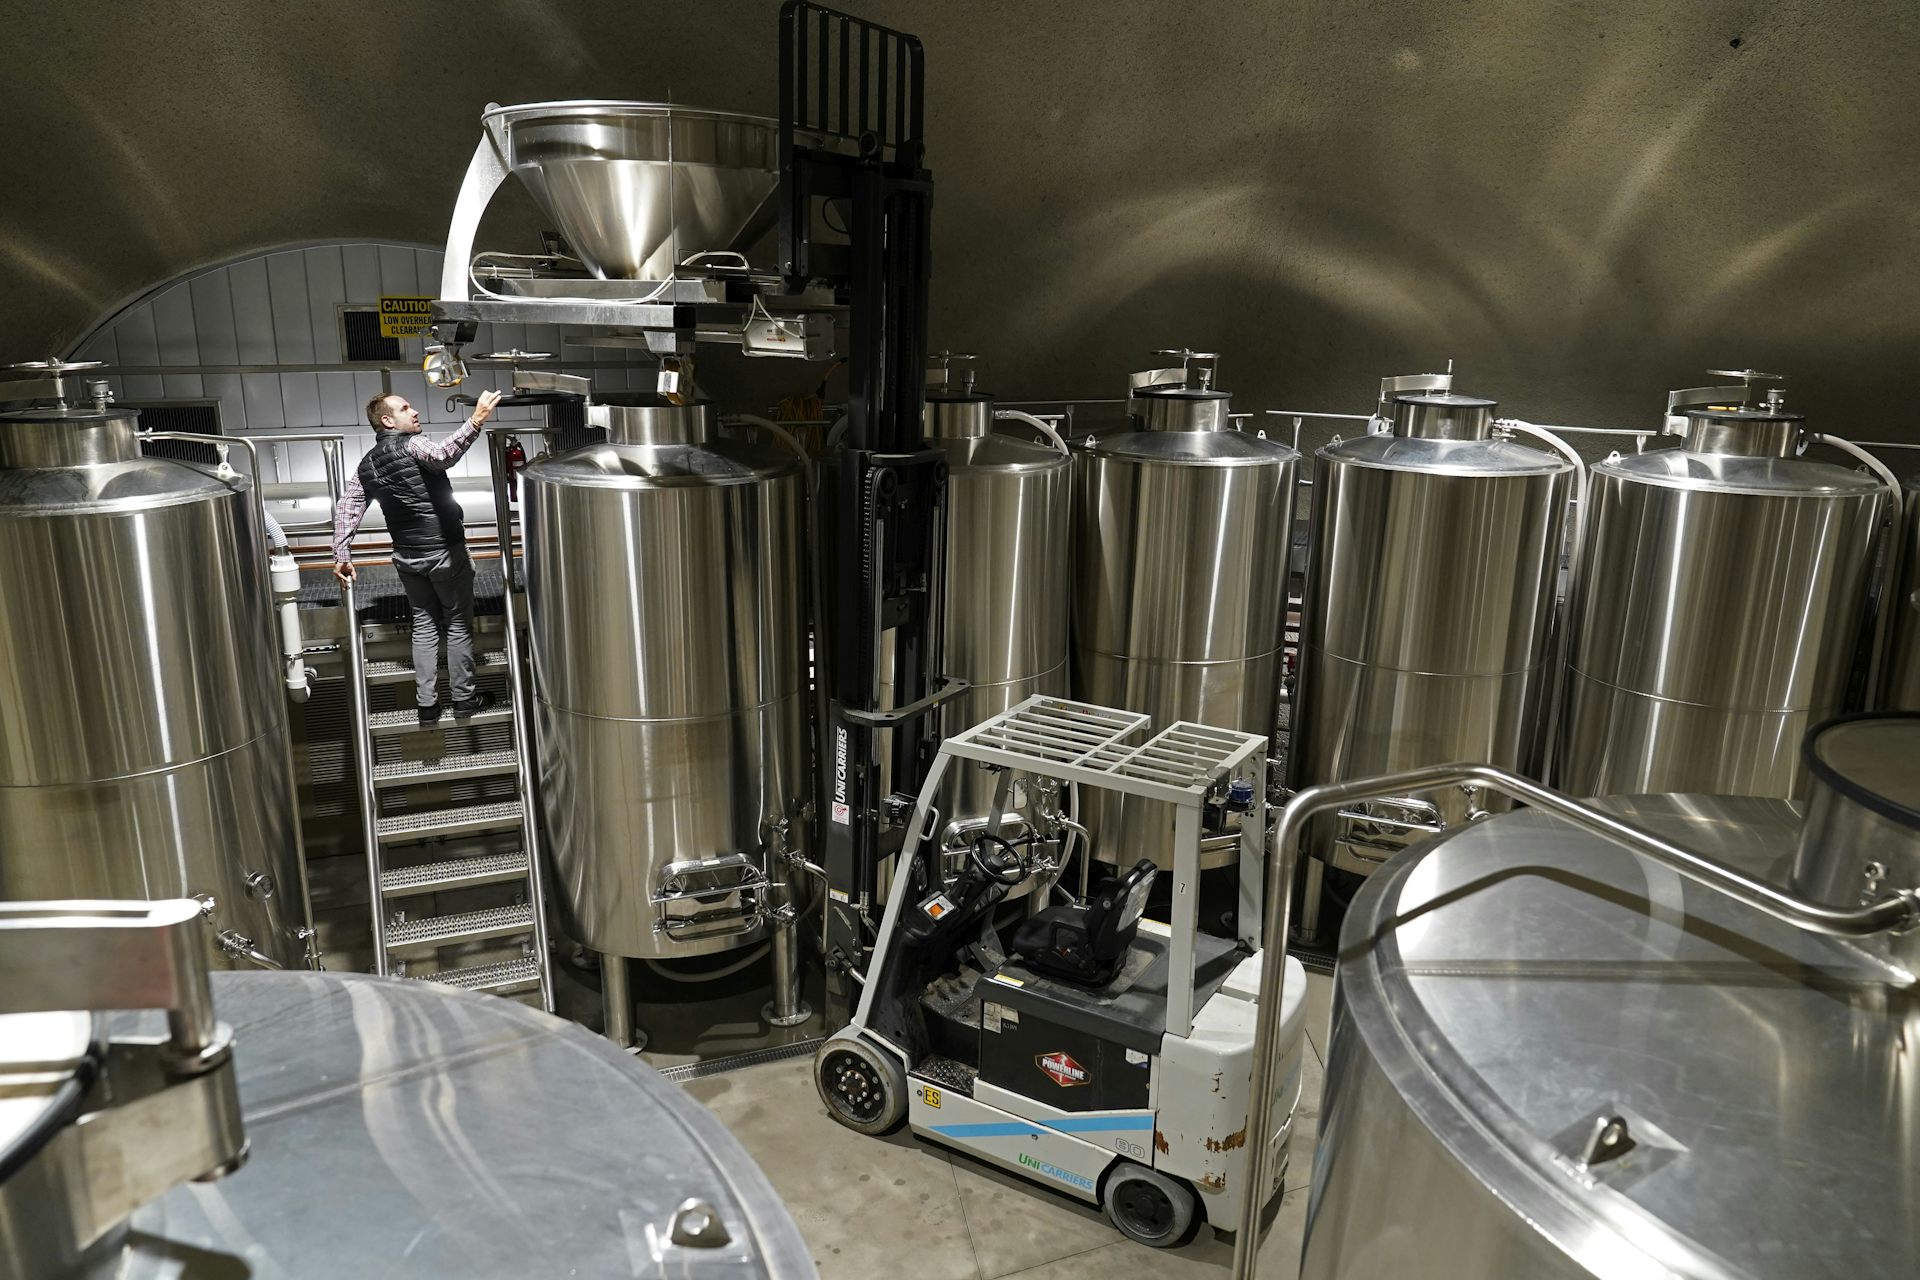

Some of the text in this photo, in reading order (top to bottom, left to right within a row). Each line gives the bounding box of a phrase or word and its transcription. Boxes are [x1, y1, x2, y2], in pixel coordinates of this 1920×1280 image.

[383, 315, 432, 325] LOW OVERHEA
[1180, 882, 1186, 894] 7
[1042, 1057, 1085, 1080] POWERLINE
[925, 1089, 939, 1105] ES
[1115, 1138, 1145, 1158] 80
